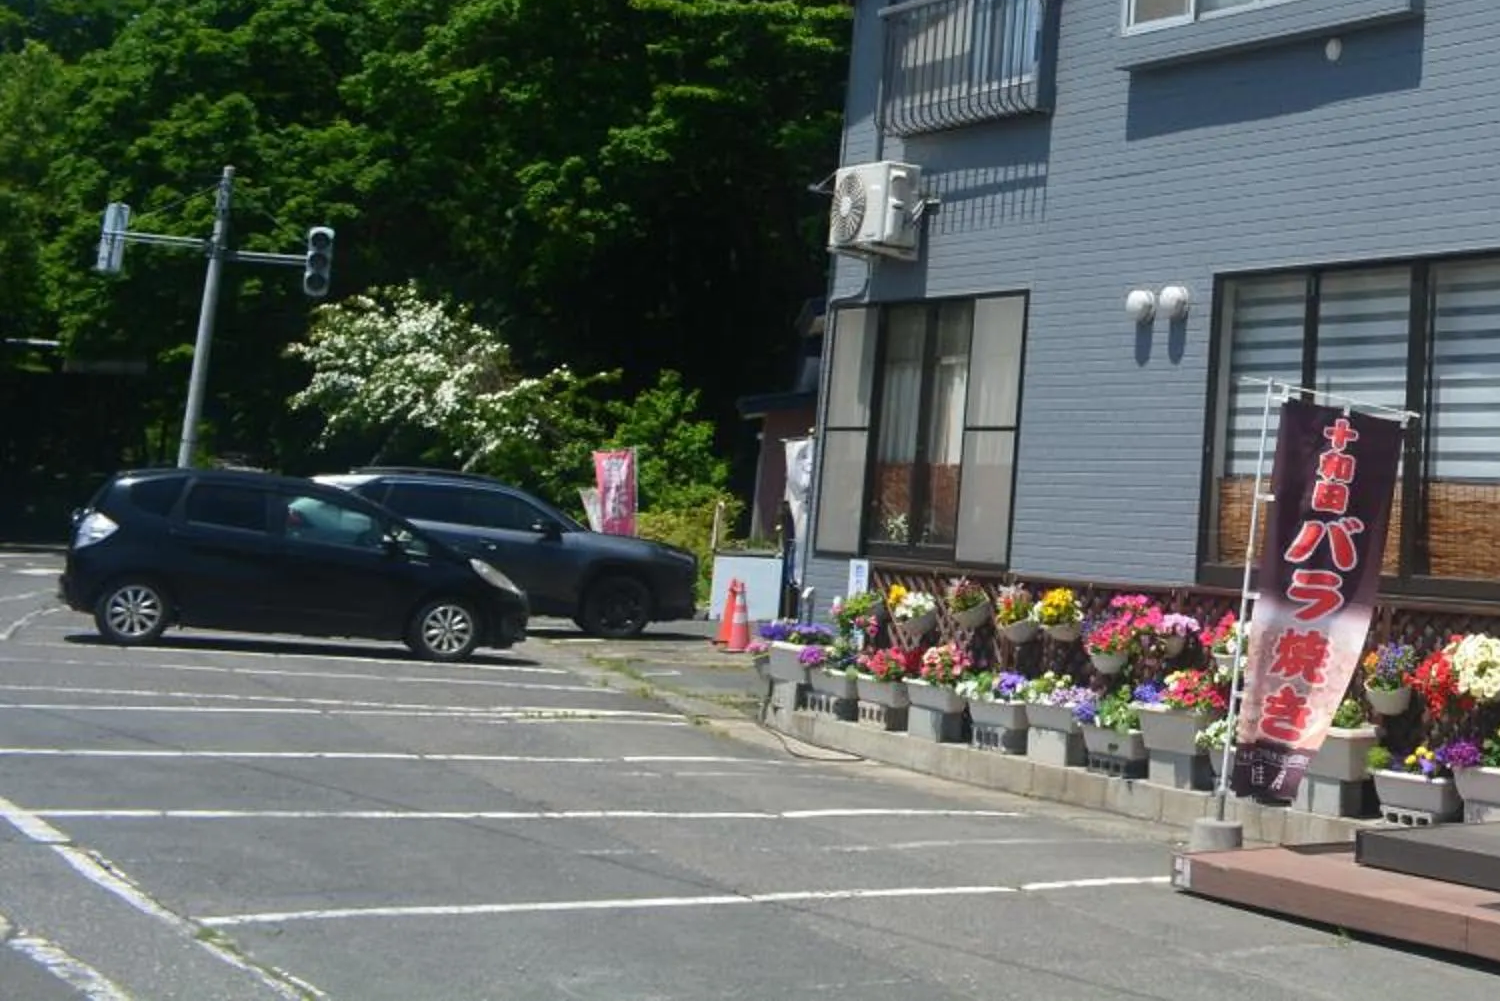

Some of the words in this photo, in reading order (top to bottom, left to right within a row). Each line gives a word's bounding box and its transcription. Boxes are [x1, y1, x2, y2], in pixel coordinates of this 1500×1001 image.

[1258, 417, 1365, 744] 十和田バラ焼き
